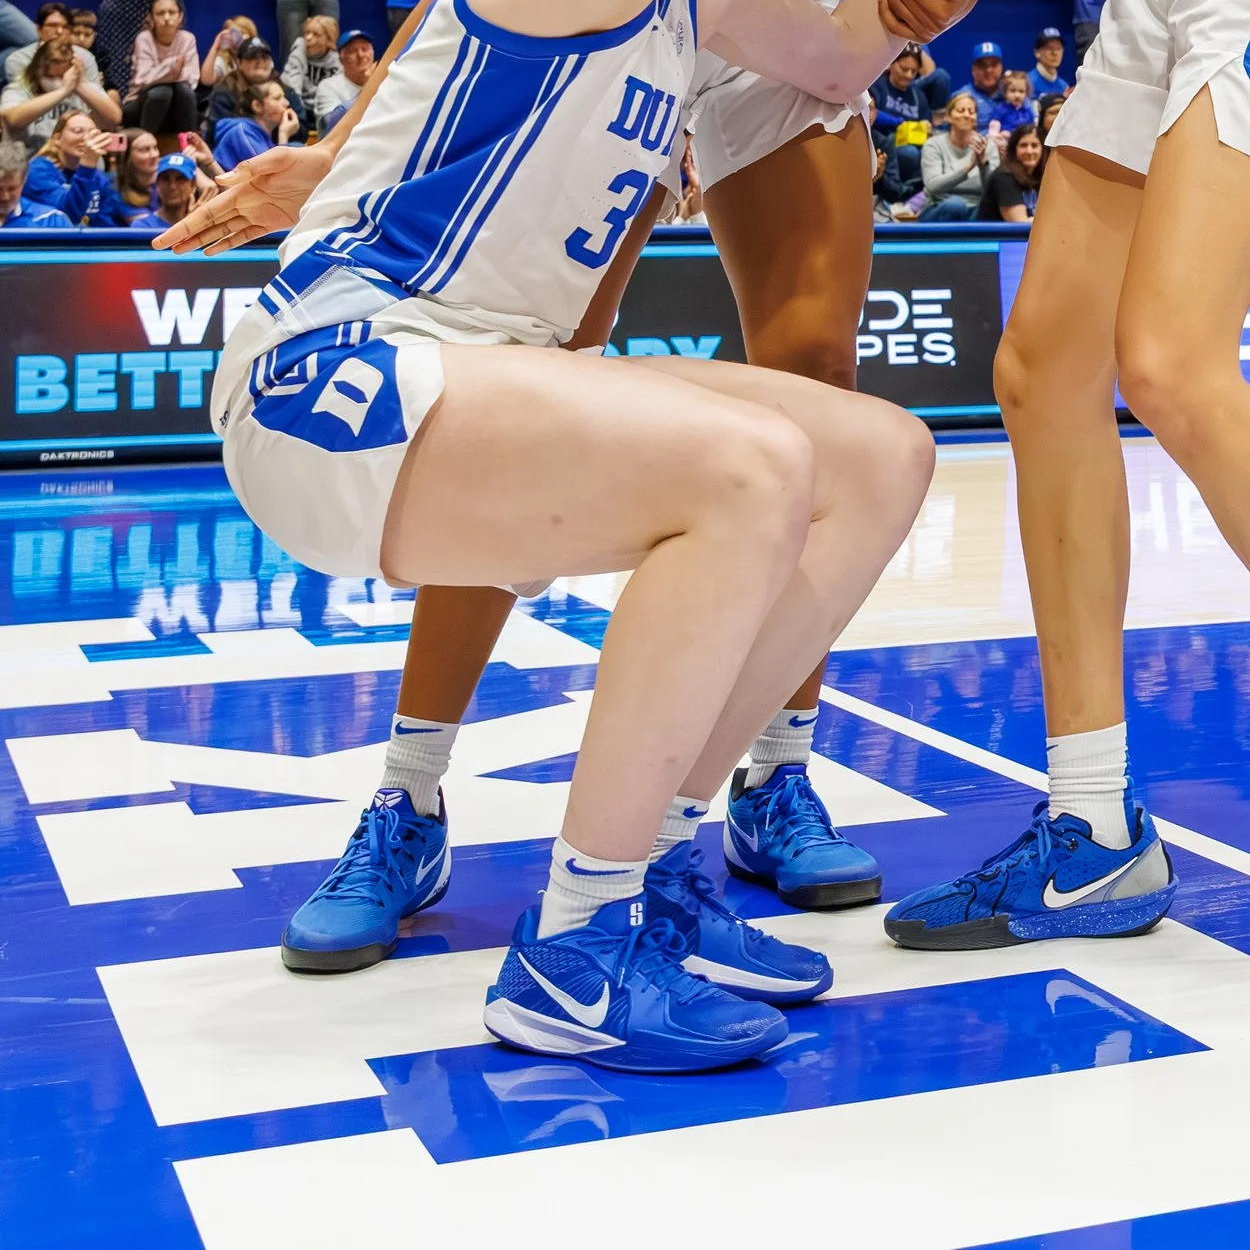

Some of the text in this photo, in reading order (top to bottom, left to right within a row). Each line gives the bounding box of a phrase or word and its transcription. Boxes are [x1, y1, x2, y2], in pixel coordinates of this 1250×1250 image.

[606, 75, 676, 157] DU
[859, 288, 953, 331] DE
[15, 350, 221, 415] BETT
[40, 449, 115, 462] DAKTRONICS
